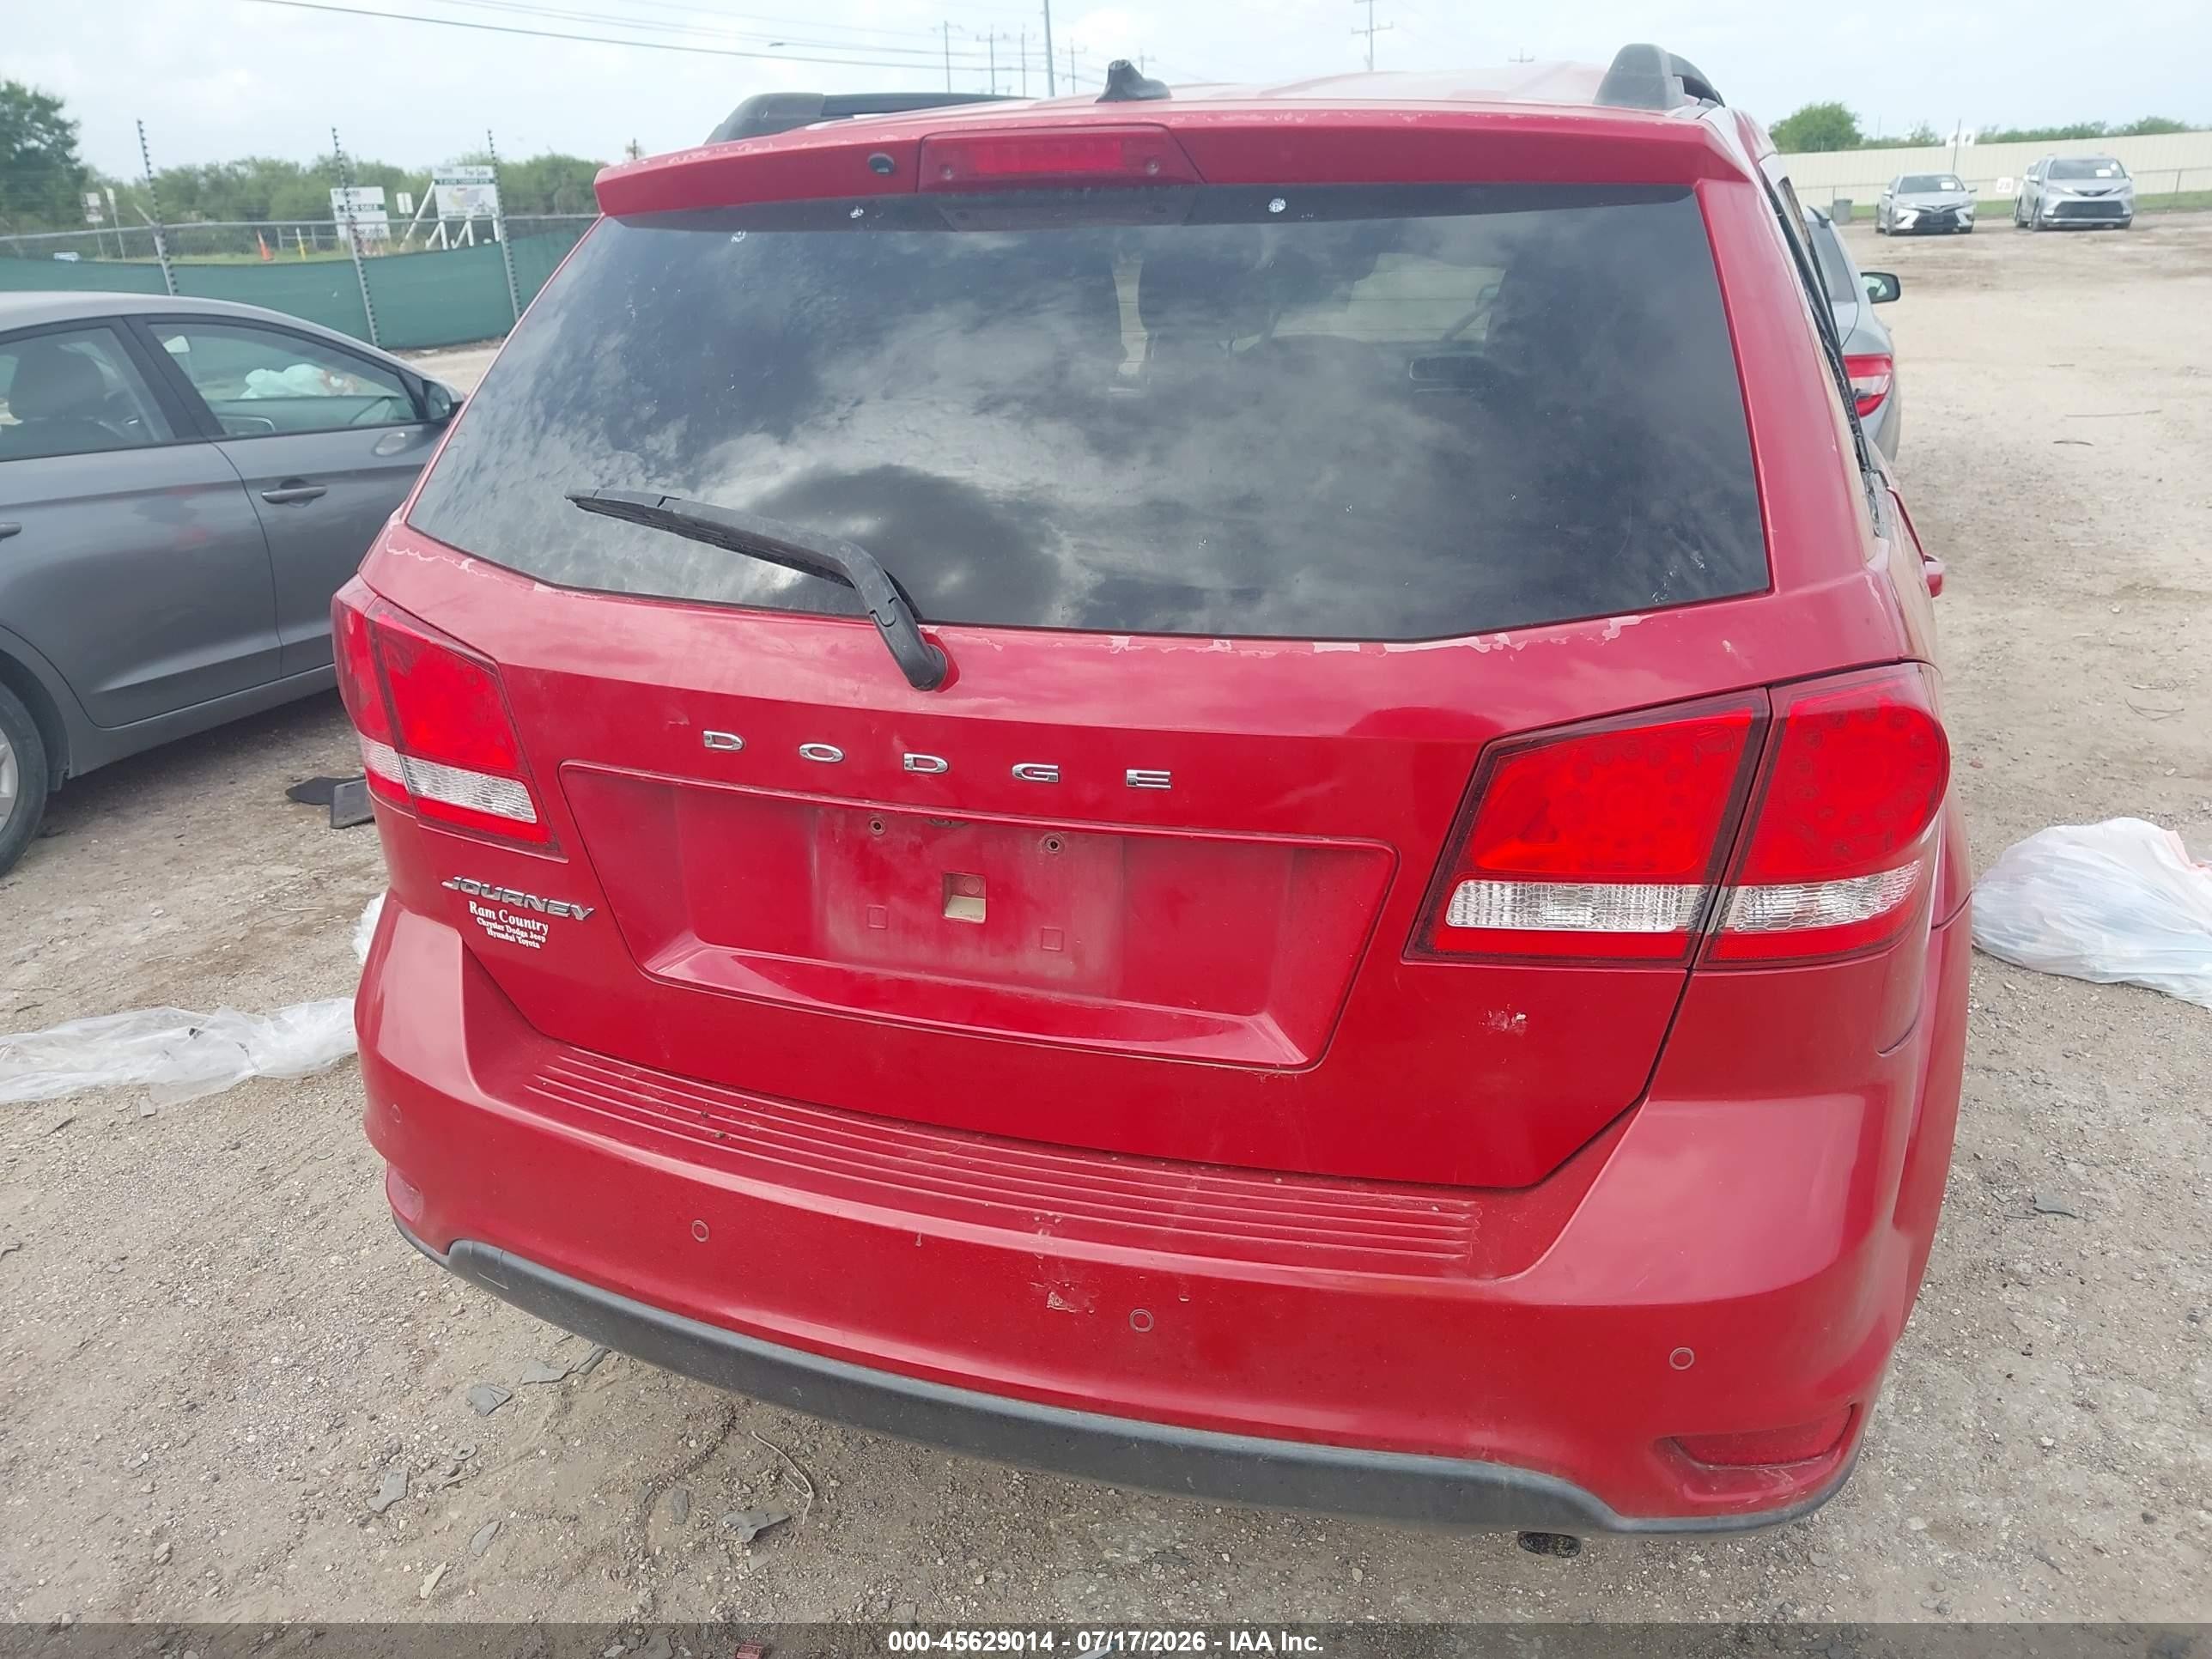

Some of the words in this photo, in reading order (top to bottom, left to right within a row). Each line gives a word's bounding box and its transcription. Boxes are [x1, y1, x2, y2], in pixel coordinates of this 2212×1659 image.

[702, 730, 1173, 790] DODGE
[441, 876, 595, 921] JOURNEY
[468, 900, 497, 921] Ram
[499, 909, 549, 935] Country
[477, 917, 505, 931] Chrysler
[505, 925, 528, 938] Dodge
[530, 932, 546, 943] Jeep
[487, 927, 516, 942] Hyundai
[516, 936, 541, 949] Toyota
